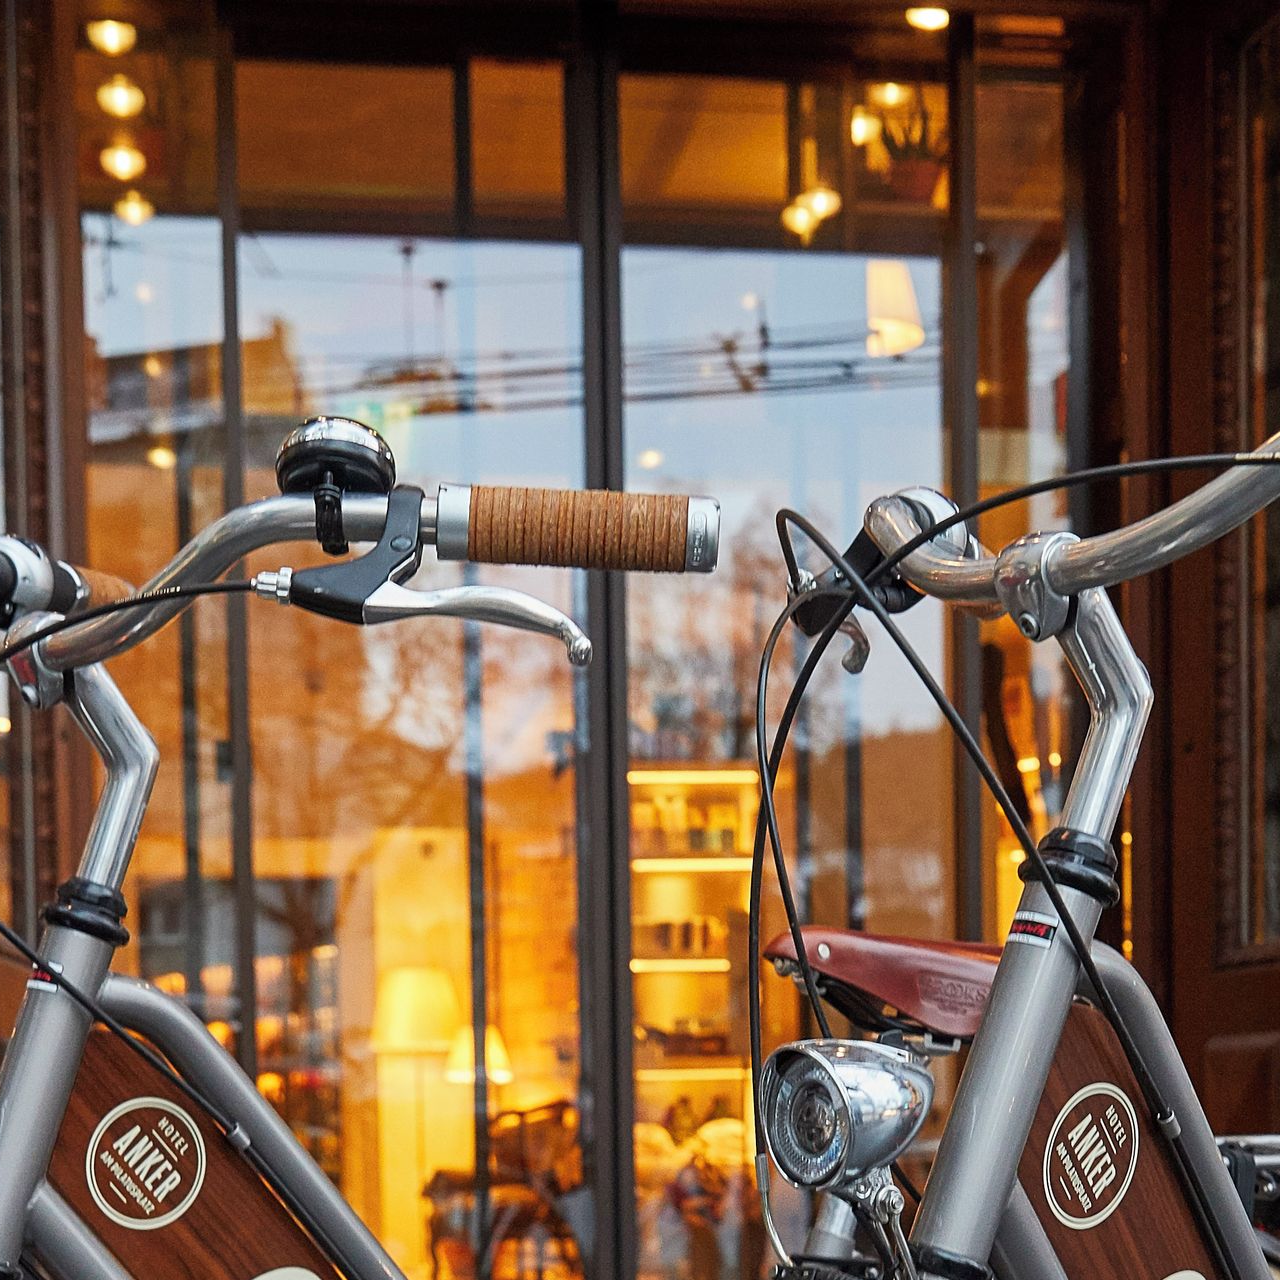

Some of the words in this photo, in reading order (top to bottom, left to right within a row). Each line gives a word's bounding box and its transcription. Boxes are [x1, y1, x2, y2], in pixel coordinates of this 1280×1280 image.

[158, 1116, 189, 1156] HOTEL
[1067, 1112, 1117, 1200] ANKER
[1105, 1104, 1127, 1148] HOTEL
[112, 1125, 181, 1203] ANKER
